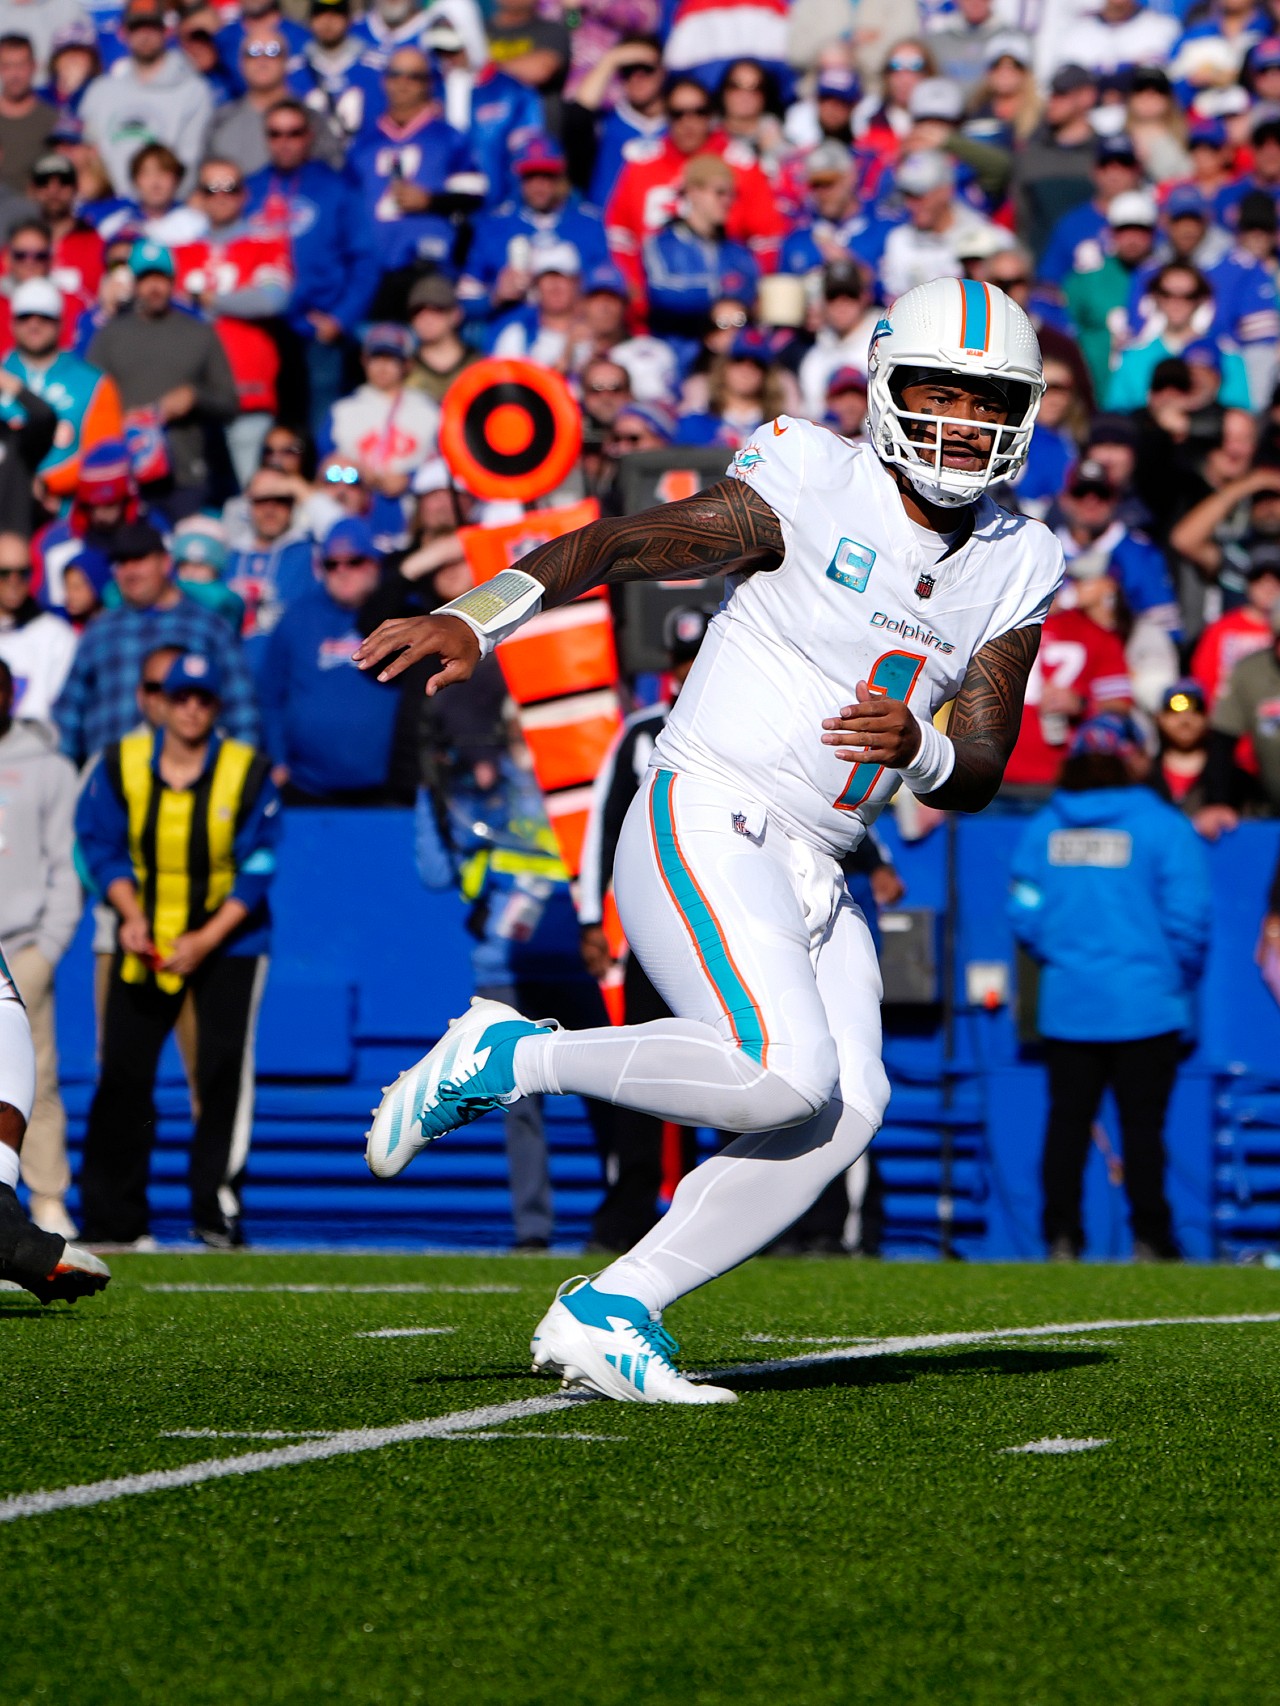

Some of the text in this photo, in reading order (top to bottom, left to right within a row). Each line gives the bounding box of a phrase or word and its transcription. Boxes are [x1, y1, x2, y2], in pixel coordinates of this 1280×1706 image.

[835, 541, 873, 580] C
[869, 611, 956, 656] Dolphins
[833, 649, 927, 811] 1
